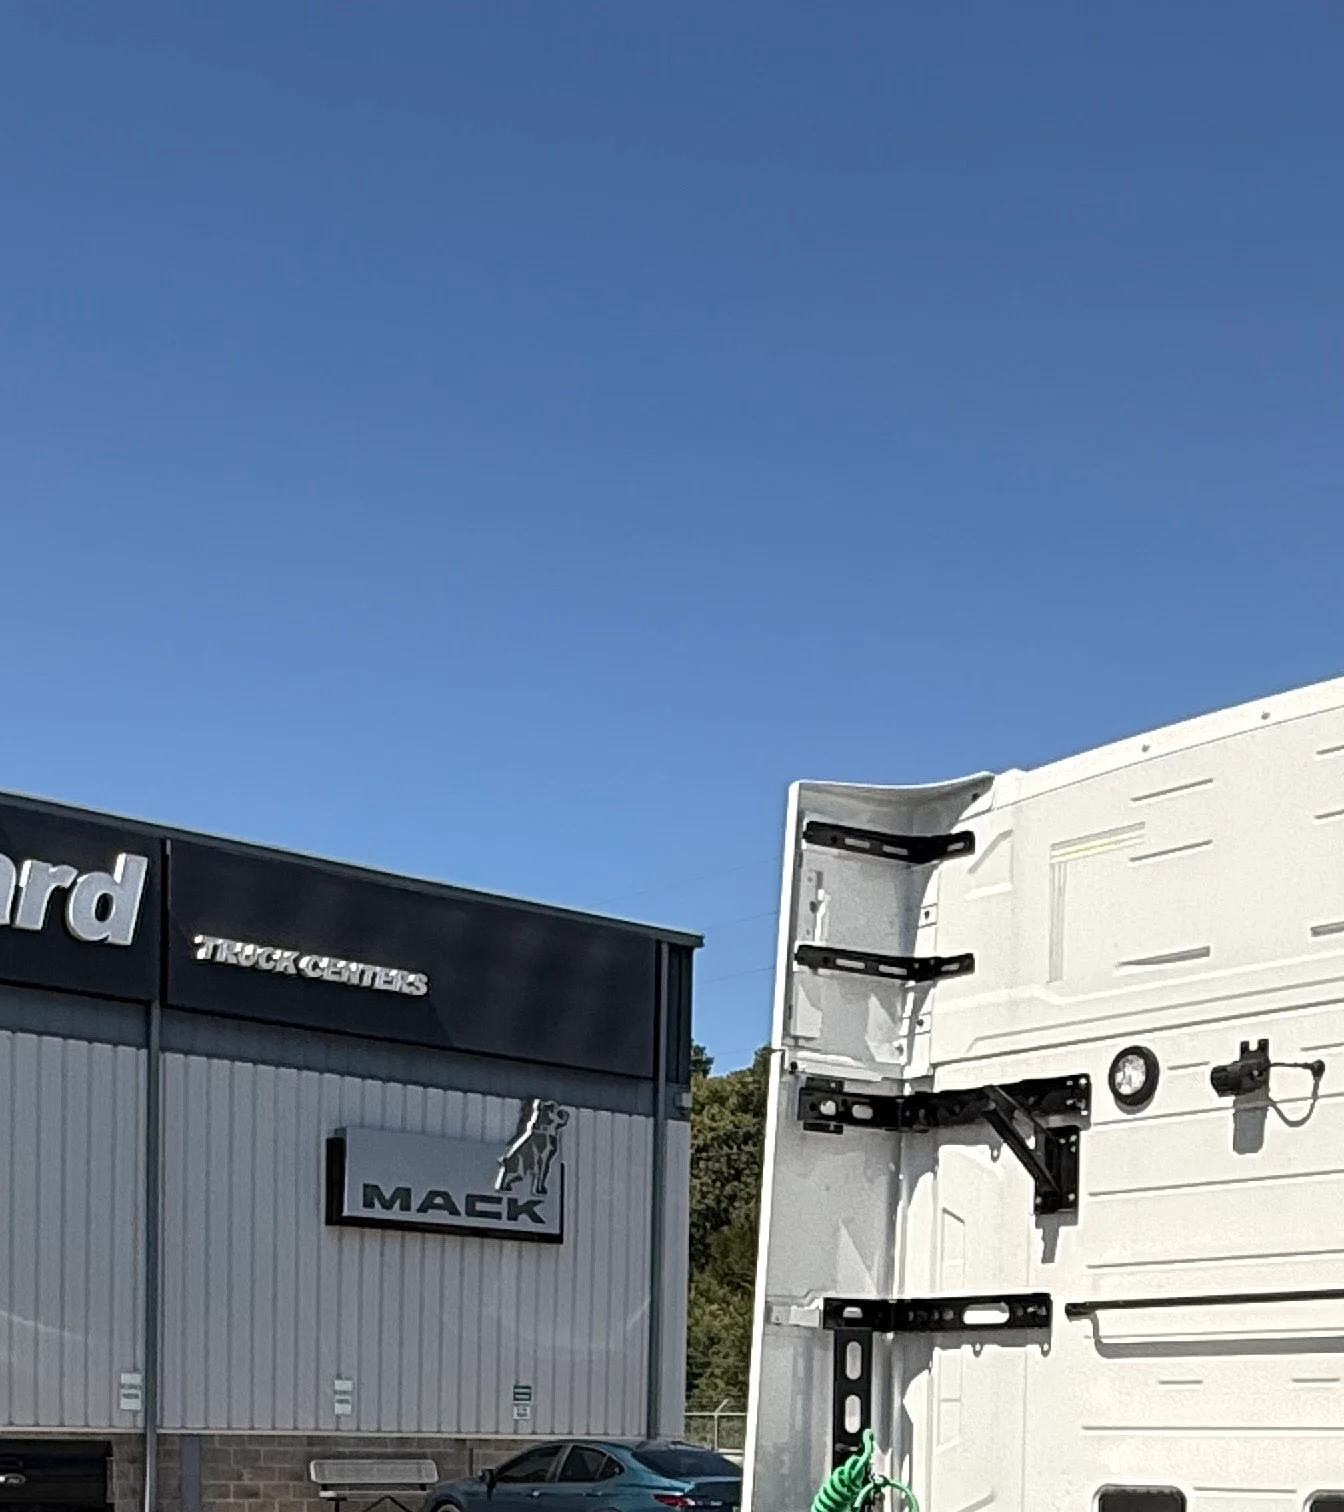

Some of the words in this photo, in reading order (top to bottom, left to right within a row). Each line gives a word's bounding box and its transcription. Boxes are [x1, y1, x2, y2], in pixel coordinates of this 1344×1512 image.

[194, 934, 300, 975] TRUCK
[298, 954, 429, 997] CENTERS
[362, 1182, 547, 1225] MACK
